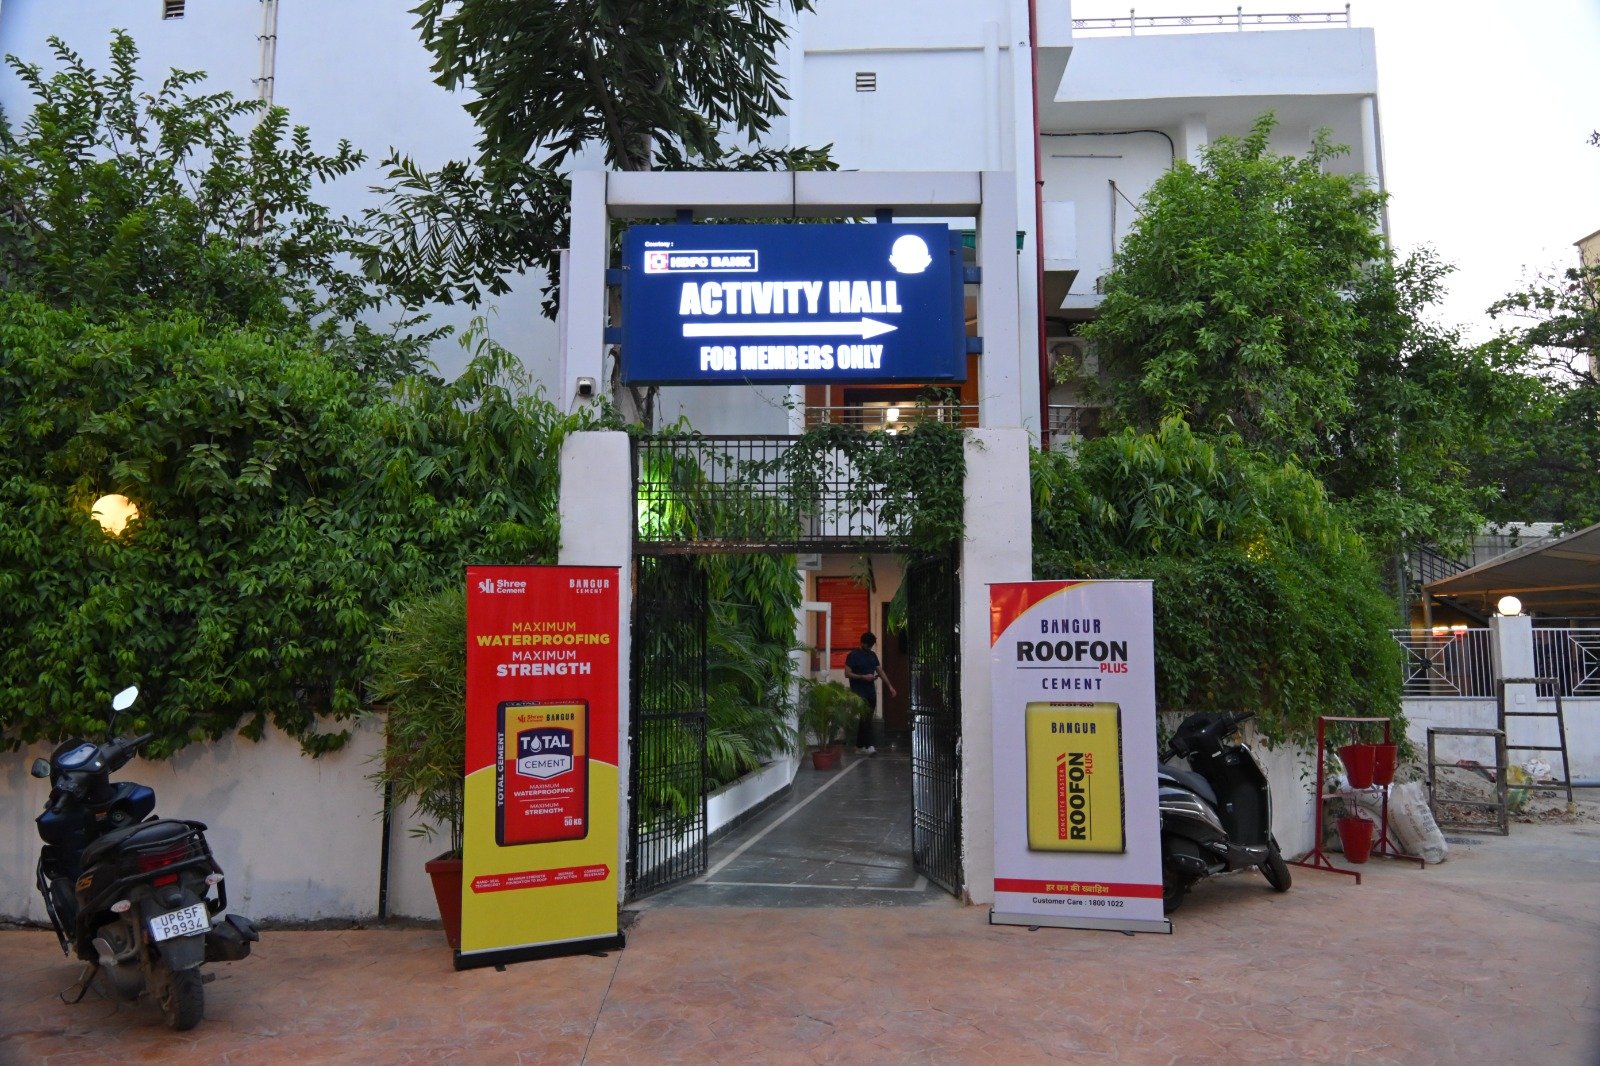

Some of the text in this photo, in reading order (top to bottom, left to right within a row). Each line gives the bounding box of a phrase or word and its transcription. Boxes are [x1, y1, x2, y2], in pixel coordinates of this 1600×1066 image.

[710, 256, 752, 267] BANK
[679, 280, 902, 315] ACTIVITY HALL
[700, 344, 884, 371] FOR MEMBERS ONLY
[496, 579, 527, 588] Shree
[569, 579, 610, 588] BANGUR
[512, 622, 576, 632] MAXIMUM
[1041, 619, 1101, 634] BANGUR
[476, 633, 610, 646] WATERPROOFING
[512, 650, 576, 661] MAXIMUM
[1016, 640, 1128, 662] ROOFON
[496, 662, 591, 676] STRENGTH
[1100, 662, 1128, 673] PLUS
[1042, 678, 1102, 690] CEMENT
[1051, 722, 1096, 734] BANGUR
[524, 758, 566, 769] CEMENT
[1084, 752, 1093, 775] PLUS
[513, 787, 574, 797] WATERPROOFING
[1068, 752, 1087, 840] ROOFON
[524, 807, 564, 816] STRENGTH
[1089, 899, 1105, 907] 1800
[160, 907, 198, 926] UP65F
